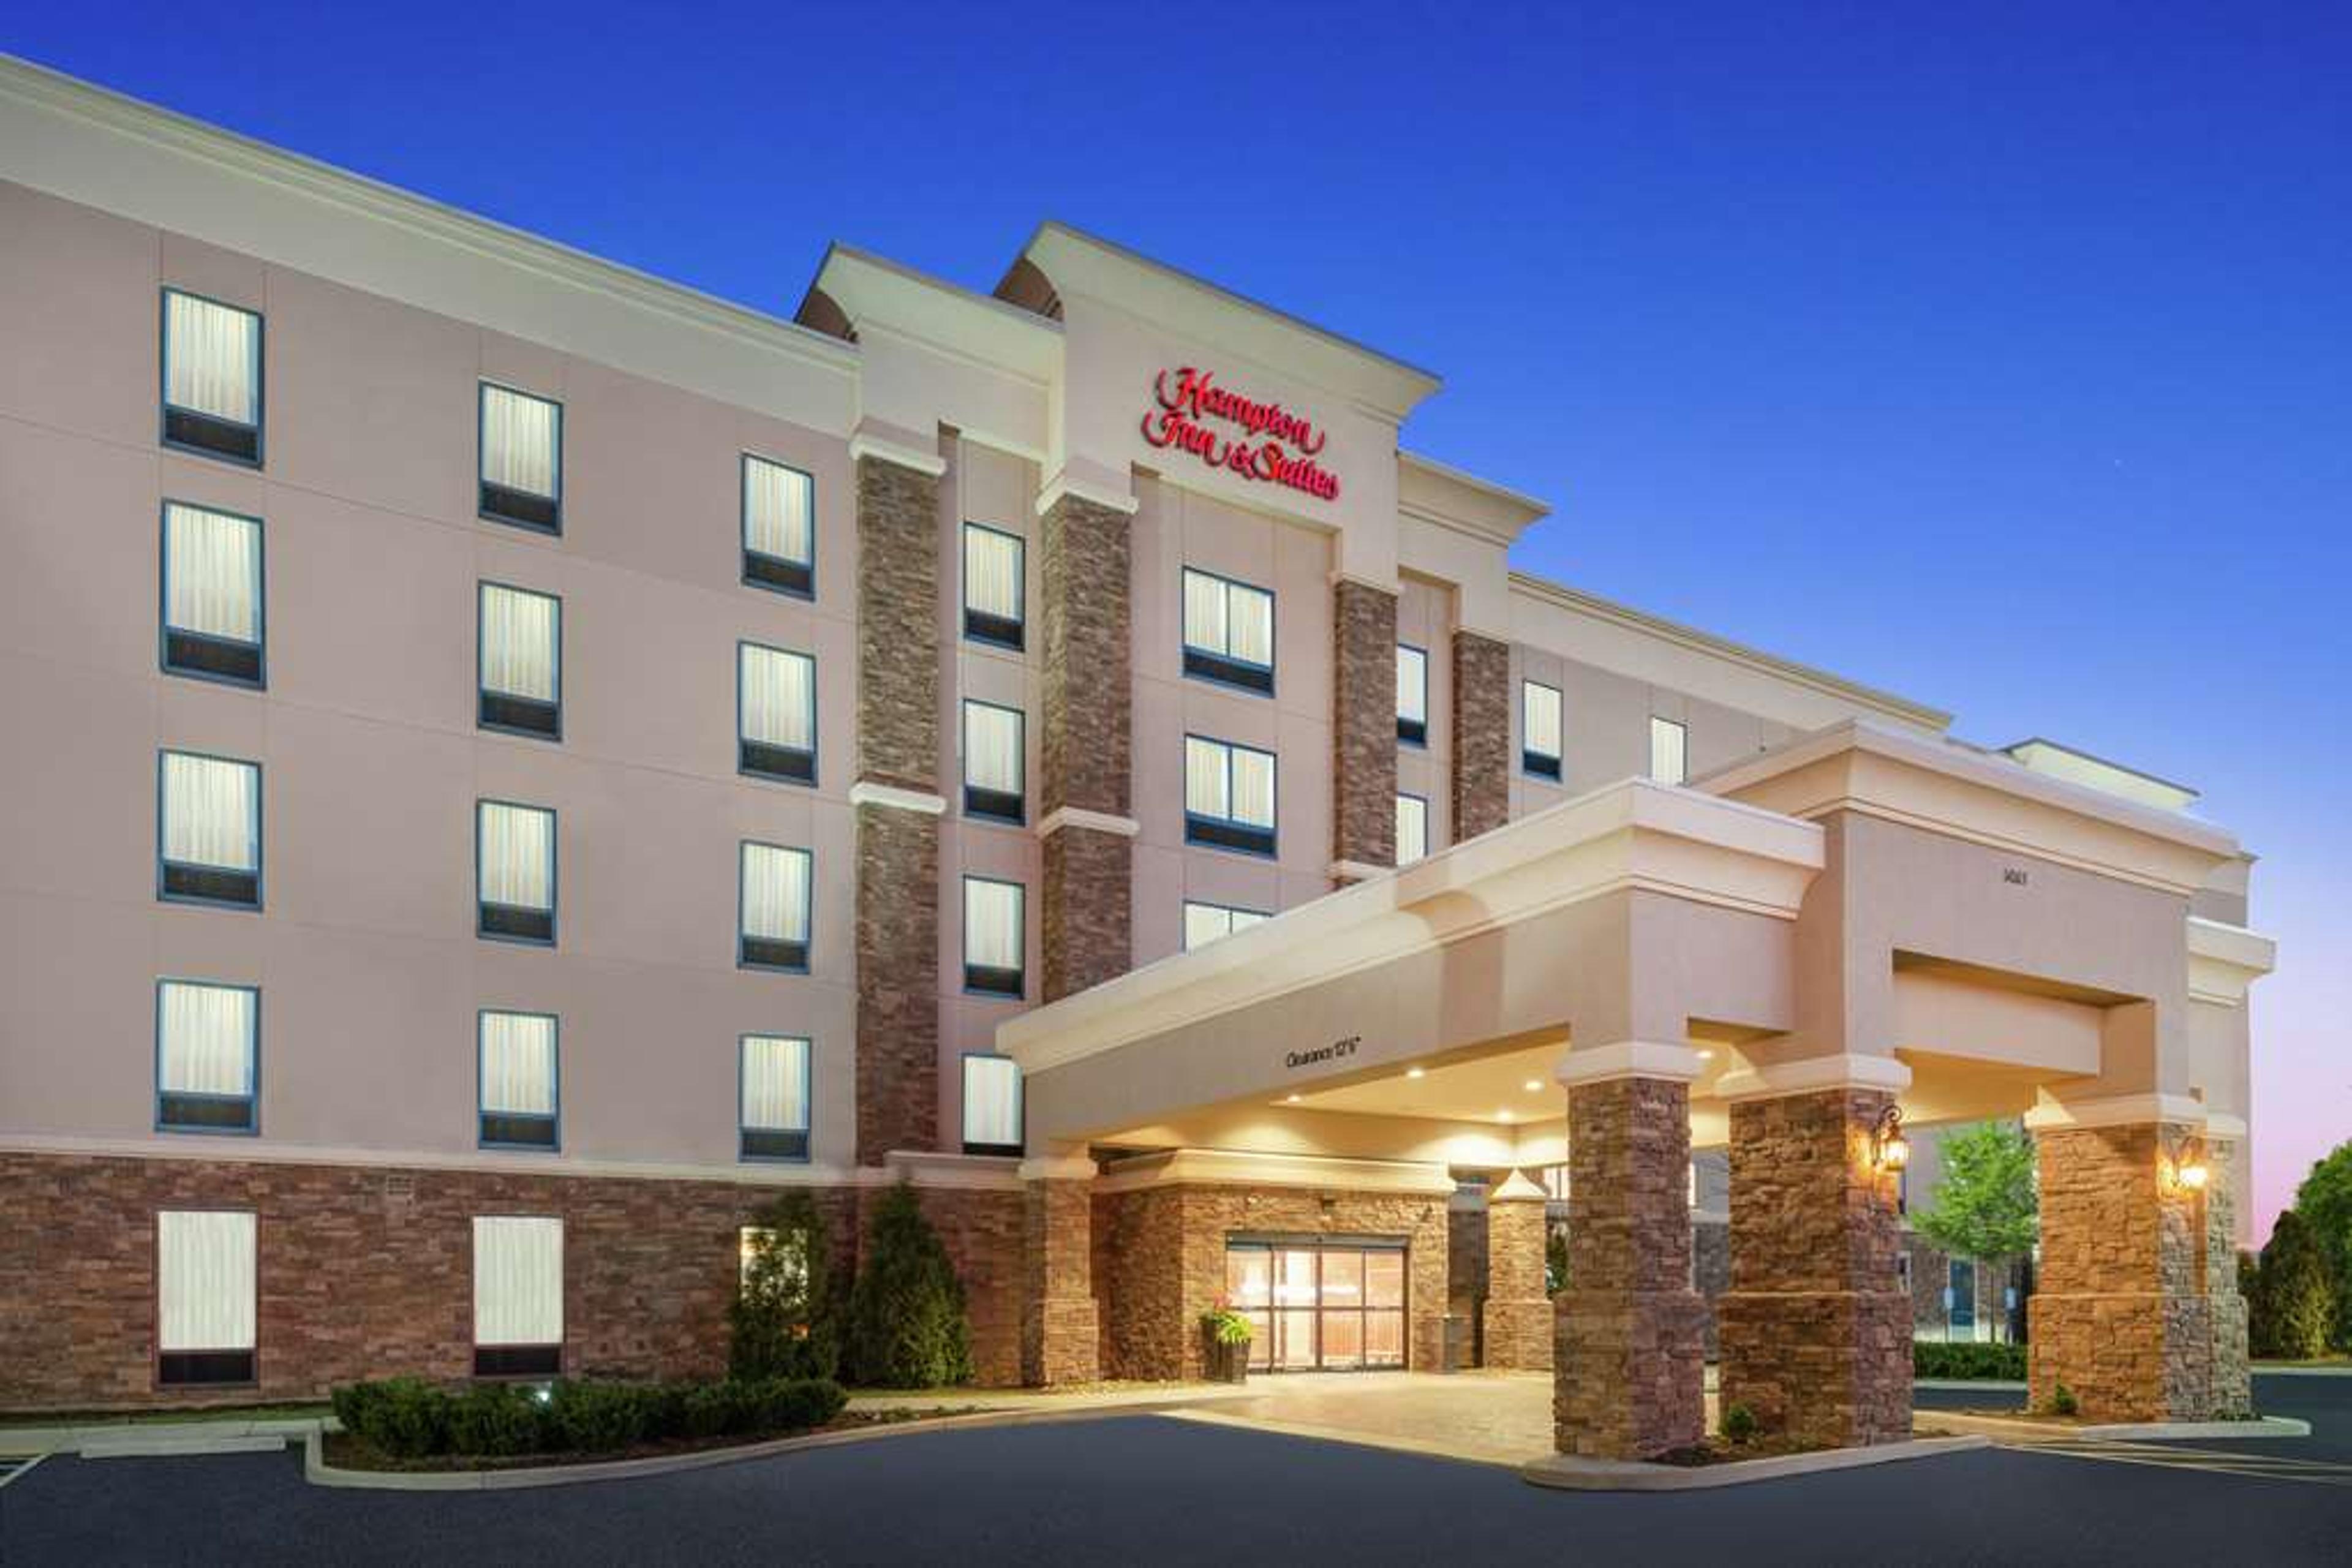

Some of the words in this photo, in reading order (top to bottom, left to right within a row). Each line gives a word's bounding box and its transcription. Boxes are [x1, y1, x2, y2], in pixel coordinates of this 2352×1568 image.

[1141, 410, 1232, 467] Inn
[1156, 368, 1325, 455] Hampton
[1287, 1047, 1333, 1068] Clearance
